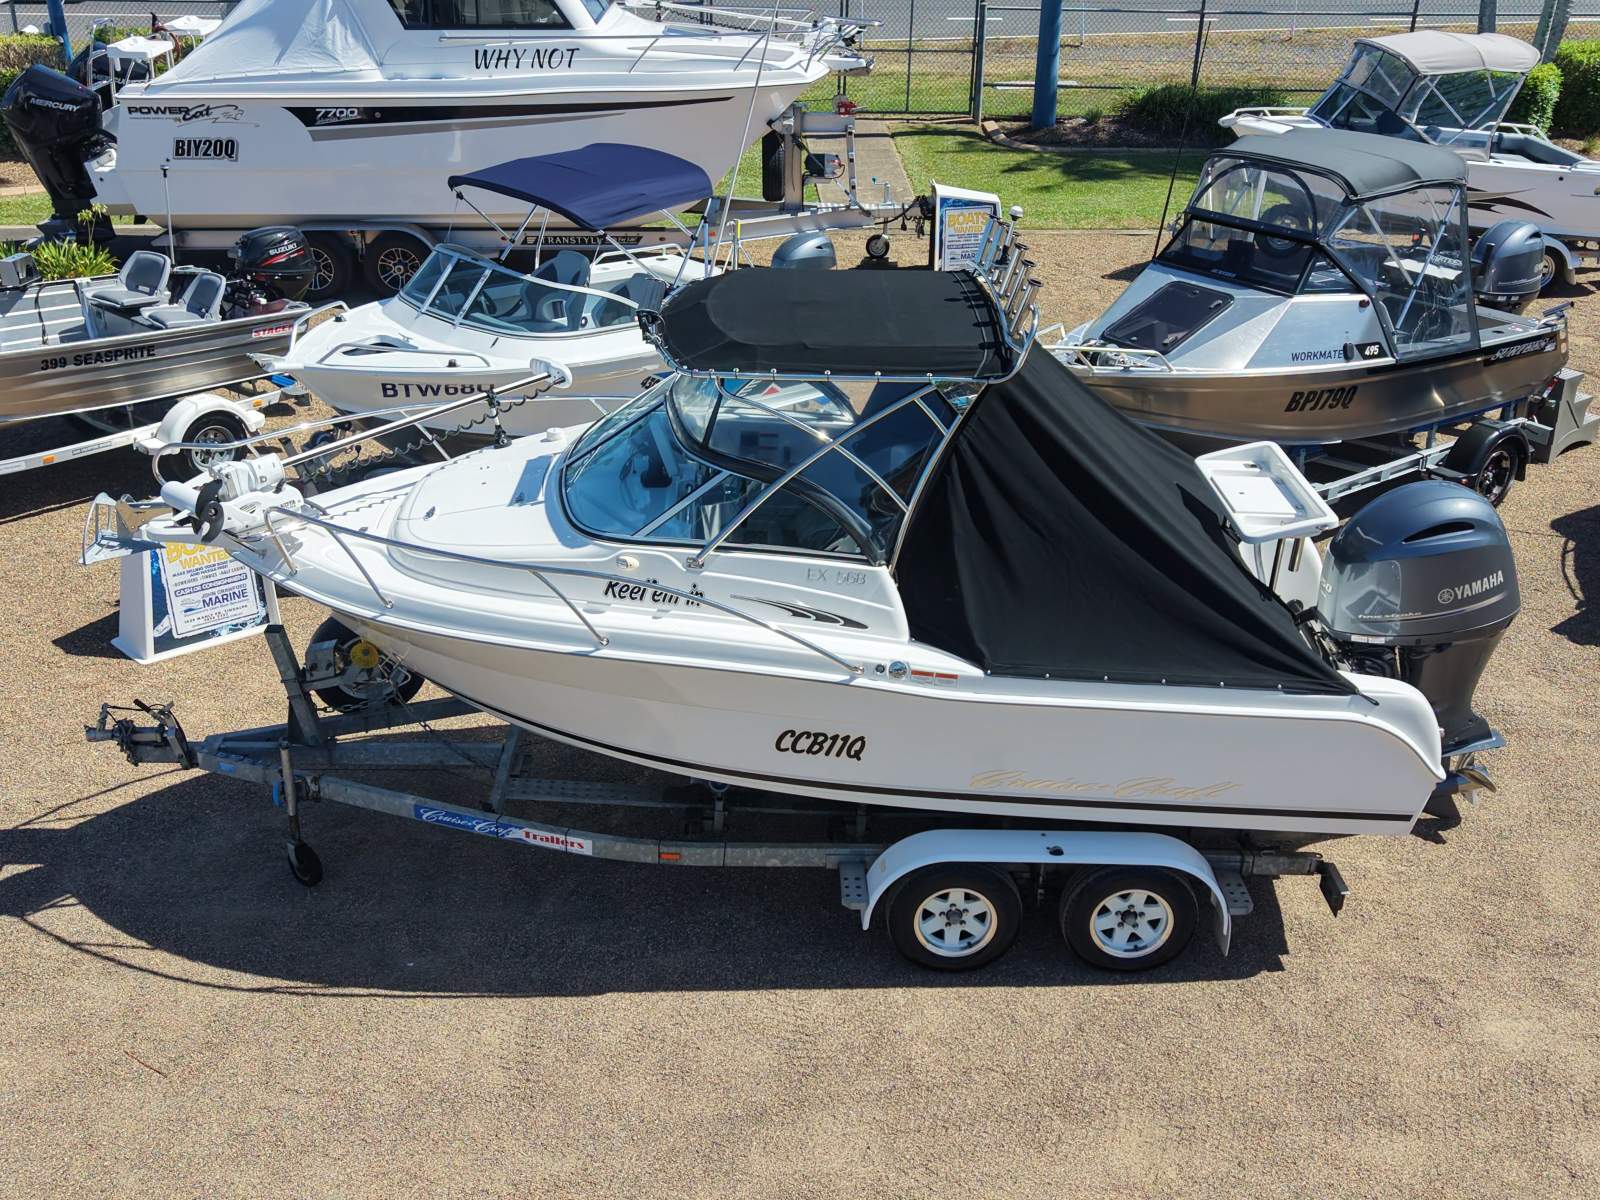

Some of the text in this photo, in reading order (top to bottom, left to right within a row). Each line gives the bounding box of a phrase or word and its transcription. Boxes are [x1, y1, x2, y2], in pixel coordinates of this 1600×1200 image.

[474, 48, 580, 69] WHY NOT
[30, 97, 80, 112] MERCURY
[315, 108, 358, 119] 7700
[174, 138, 237, 159] BIY20Q
[269, 242, 297, 255] SUZUKI
[40, 345, 156, 370] 399 SEASPRITE
[1291, 344, 1380, 361] WORKMATE 495
[1284, 385, 1359, 412] BPJ79Q
[1454, 570, 1504, 600] YAMAHA
[202, 588, 248, 608] MARINE
[775, 729, 866, 761] CCB11Q
[522, 830, 585, 849] Trailers
